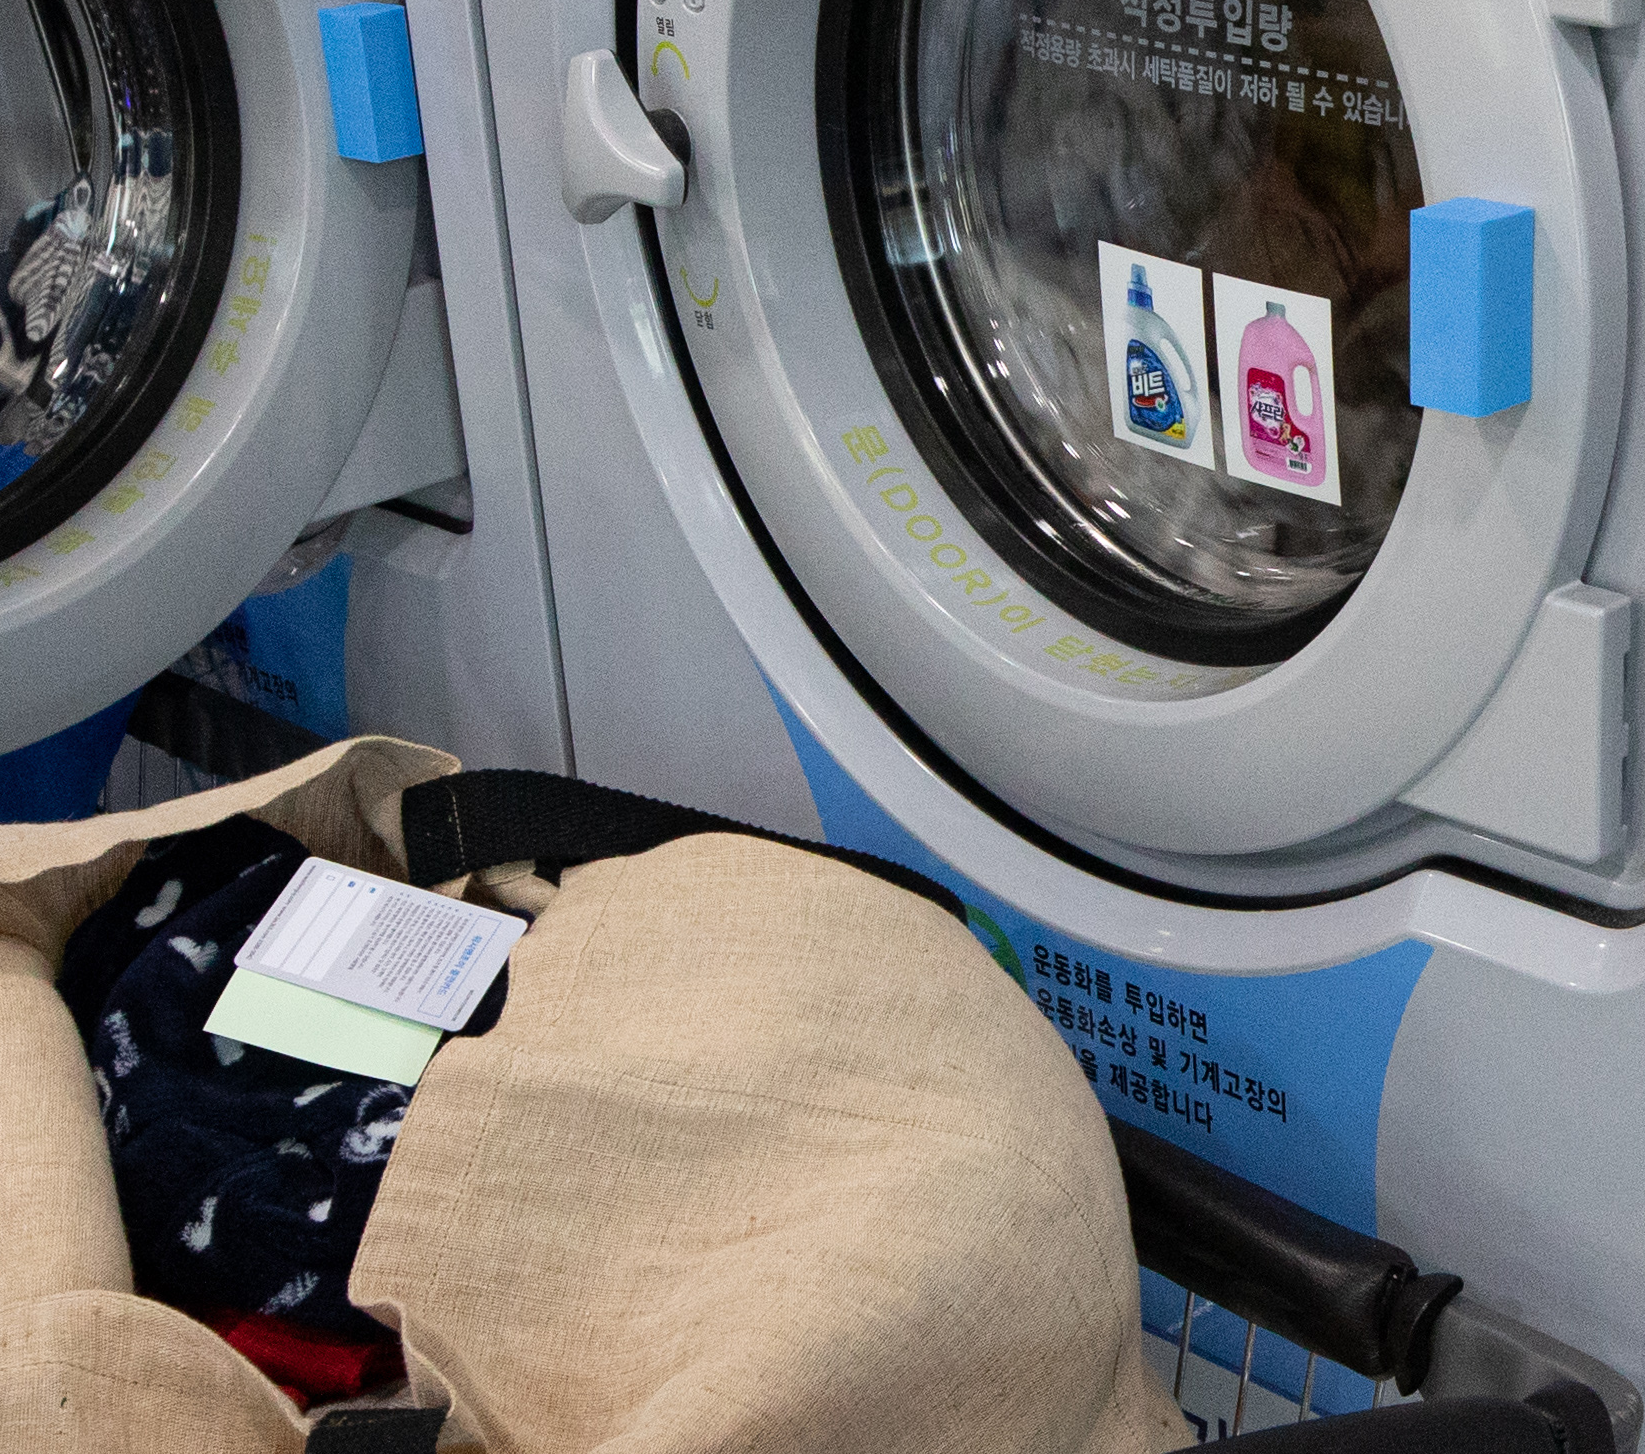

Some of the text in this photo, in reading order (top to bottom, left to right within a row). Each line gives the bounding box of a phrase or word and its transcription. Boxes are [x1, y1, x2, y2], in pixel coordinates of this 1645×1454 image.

[1020, 30, 1410, 130] 적정용량 초과시 세탁품질이 저하 될 수 있습니
[1132, 370, 1165, 396] 비트
[1251, 400, 1285, 422] 사프란
[1033, 944, 1208, 1045] 운동화를 투입하면
[1035, 988, 1137, 1057] 운동화손상
[1149, 1035, 1167, 1071] 및
[1181, 1051, 1287, 1123] 기계고장의
[1109, 1063, 1213, 1133] 제공합니다
